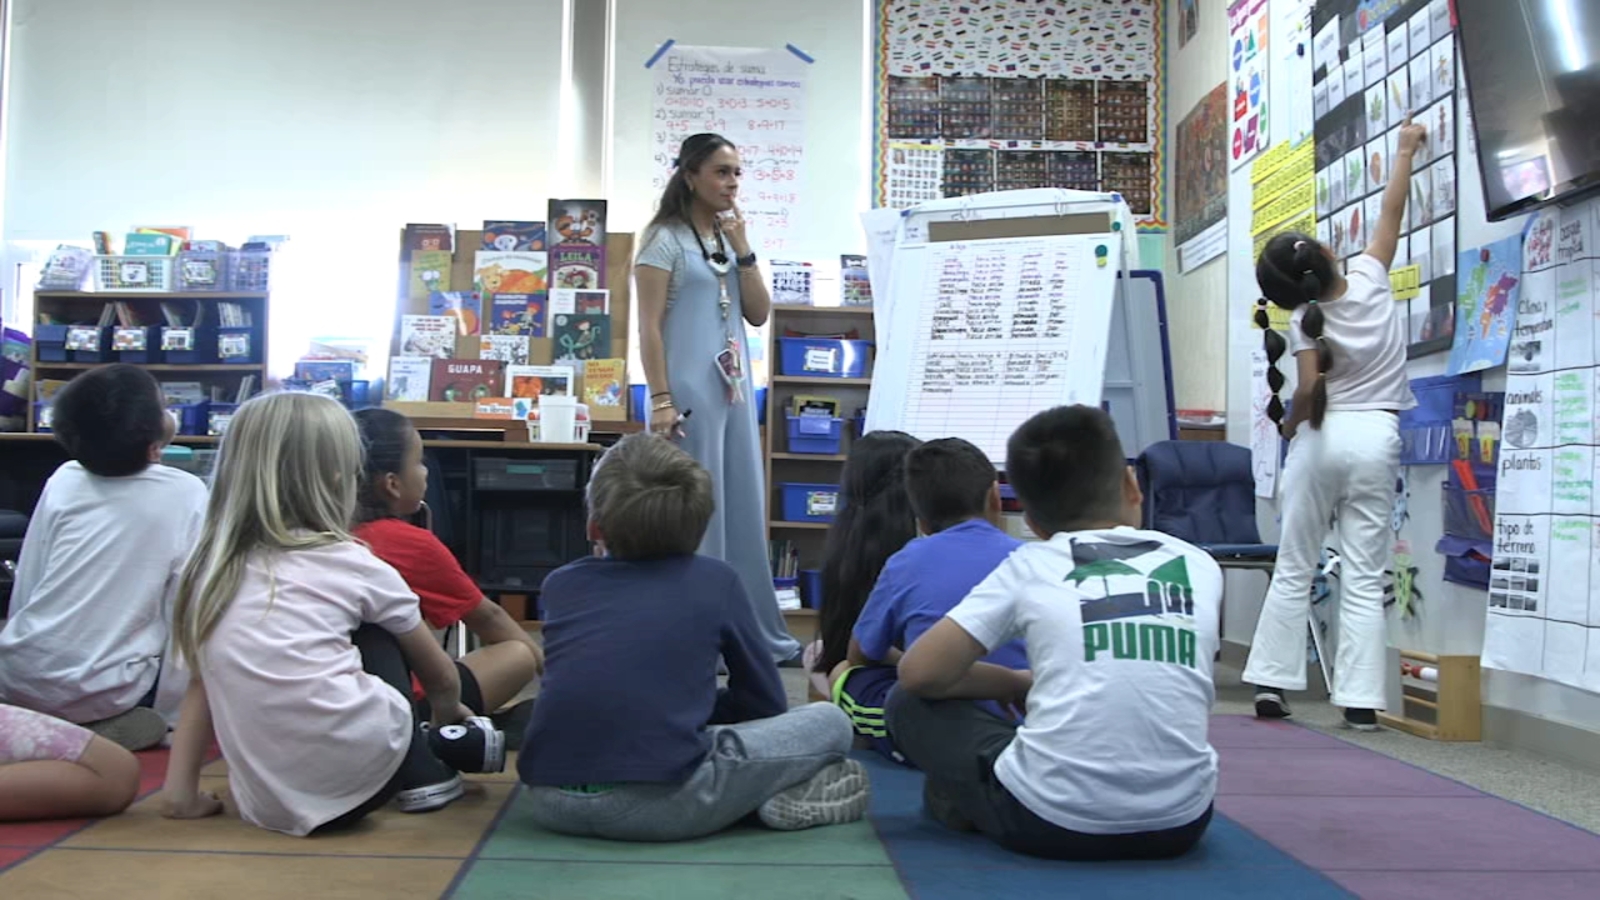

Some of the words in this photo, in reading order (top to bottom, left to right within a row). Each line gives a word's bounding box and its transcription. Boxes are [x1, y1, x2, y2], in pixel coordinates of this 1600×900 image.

[560, 252, 593, 261] LEILA
[447, 364, 483, 375] GUAPA
[1497, 517, 1520, 540] tipo
[1082, 621, 1197, 669] PUMA
